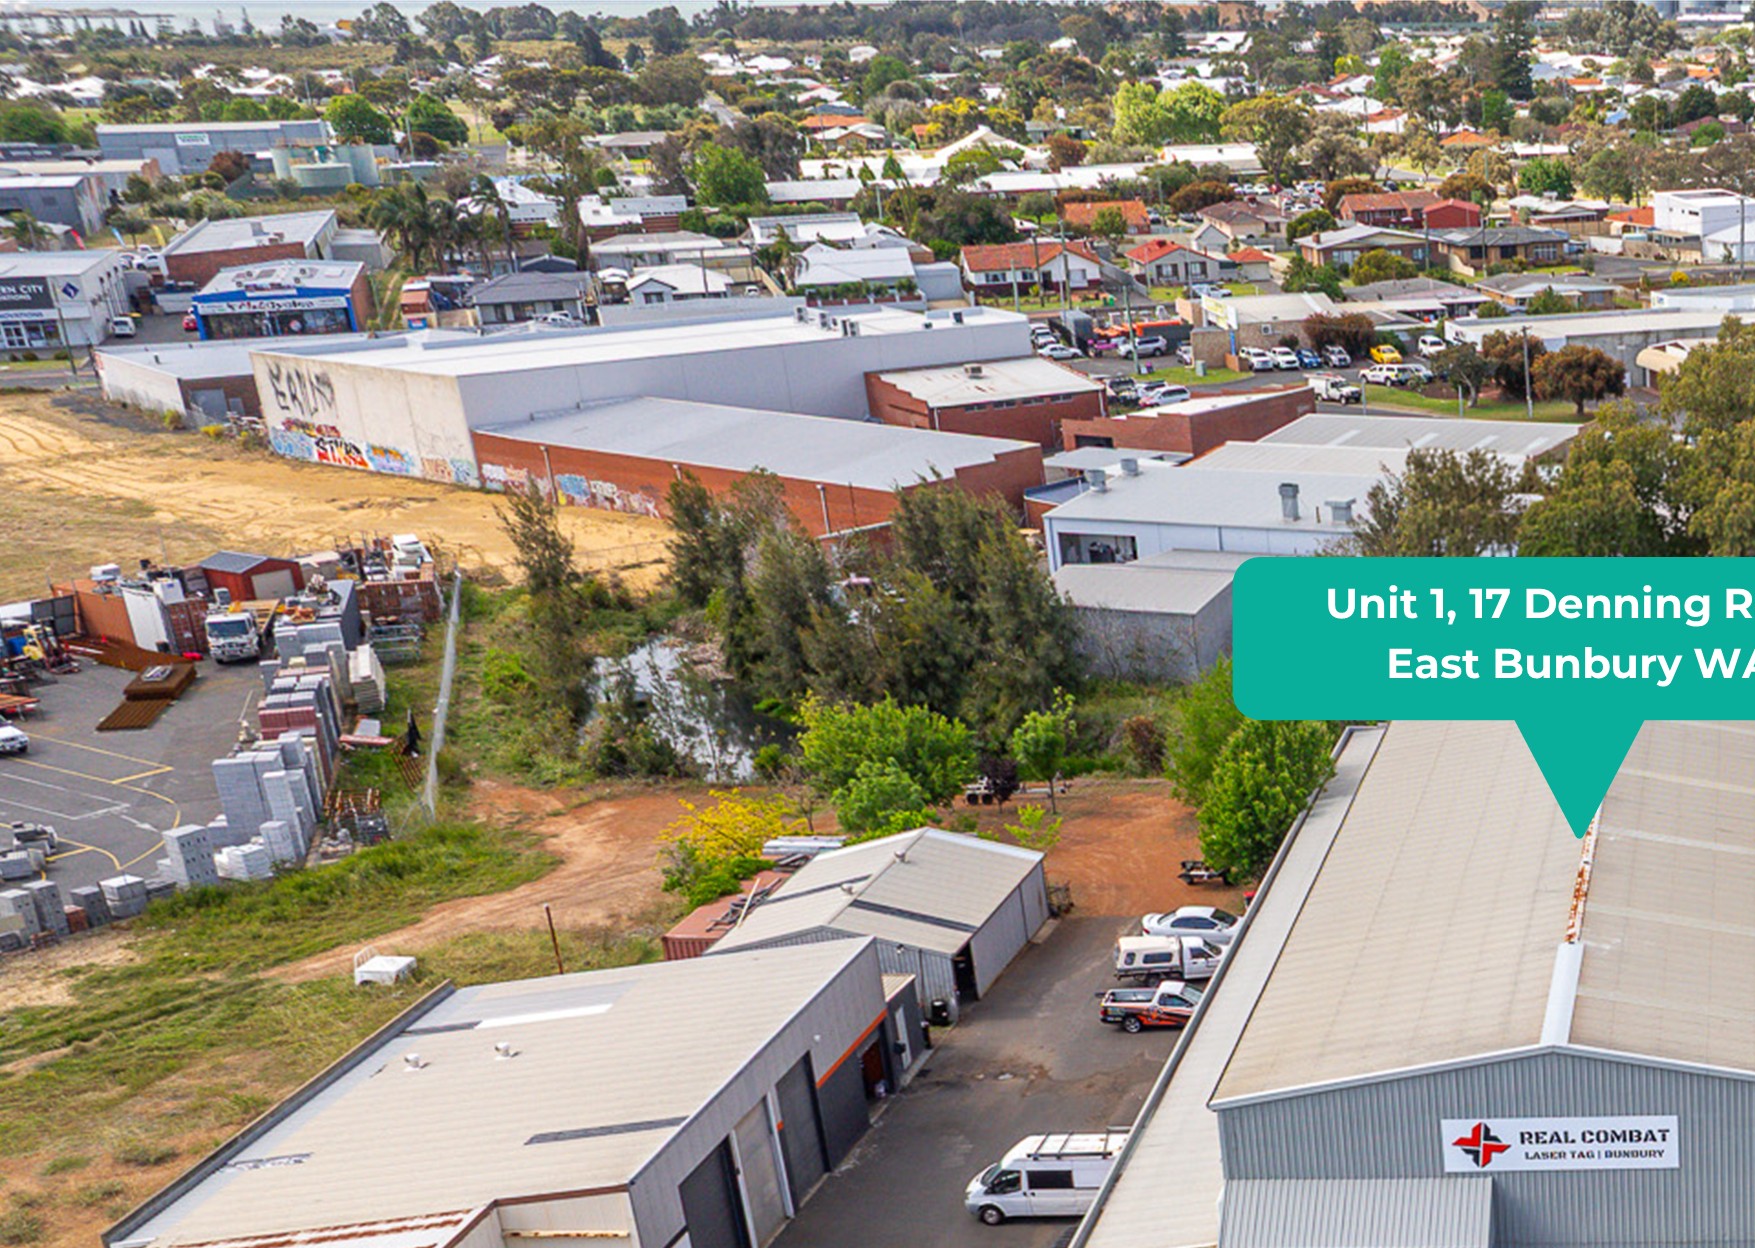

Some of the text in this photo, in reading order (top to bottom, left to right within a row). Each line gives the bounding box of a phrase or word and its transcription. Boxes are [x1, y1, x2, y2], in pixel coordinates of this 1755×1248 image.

[19, 284, 44, 294] CITY
[1519, 1129, 1670, 1145] REAL COMBAT
[1525, 1149, 1567, 1160] LASER
[1570, 1149, 1595, 1160] TAG
[1605, 1148, 1665, 1160] BUNBURY
